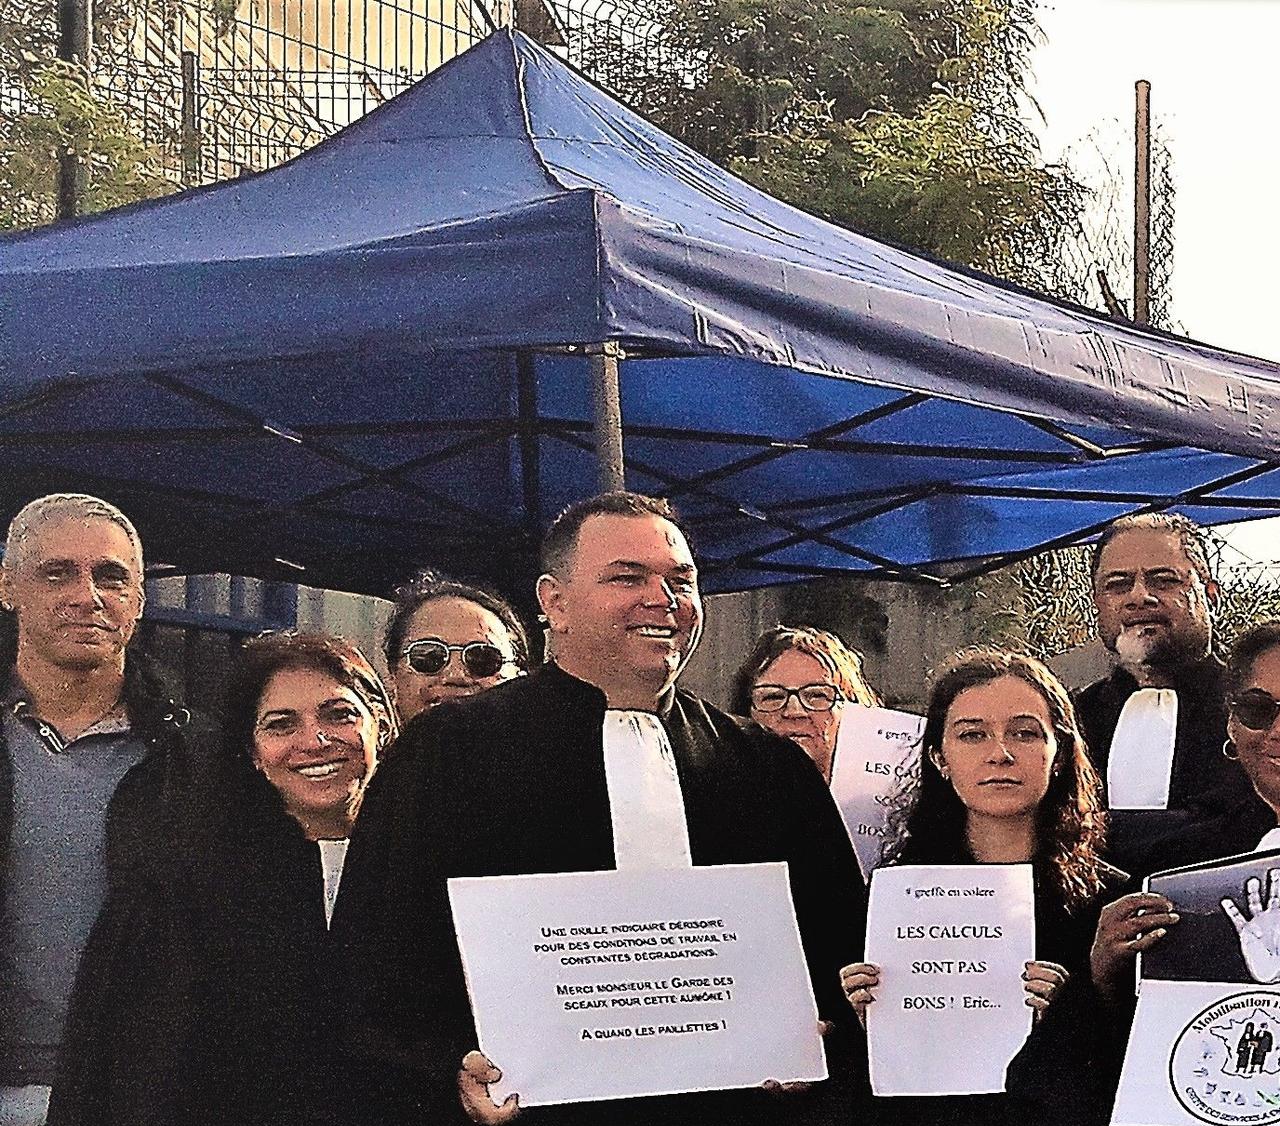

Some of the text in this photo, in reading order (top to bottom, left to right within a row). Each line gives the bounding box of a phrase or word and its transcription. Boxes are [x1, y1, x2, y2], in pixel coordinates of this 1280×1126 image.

[865, 761, 890, 776] LES
[897, 926, 1003, 939] LES CALCULS
[534, 932, 737, 952] POUR DES CONDITIONS DE TRAVAIL EN
[560, 952, 631, 966] CONSTANTES
[912, 962, 987, 974] SONT PAS
[656, 980, 668, 990] LE
[714, 977, 734, 986] DES
[564, 1000, 608, 1010] SCEAUX
[612, 997, 642, 1007] POUR
[644, 996, 676, 1005] CETTE
[904, 996, 946, 1010] BONS
[1192, 998, 1270, 1034] Mobilisation
[595, 1028, 632, 1039] QUAND
[636, 1026, 655, 1036] LES
[658, 1022, 718, 1034] PAILLETTES
